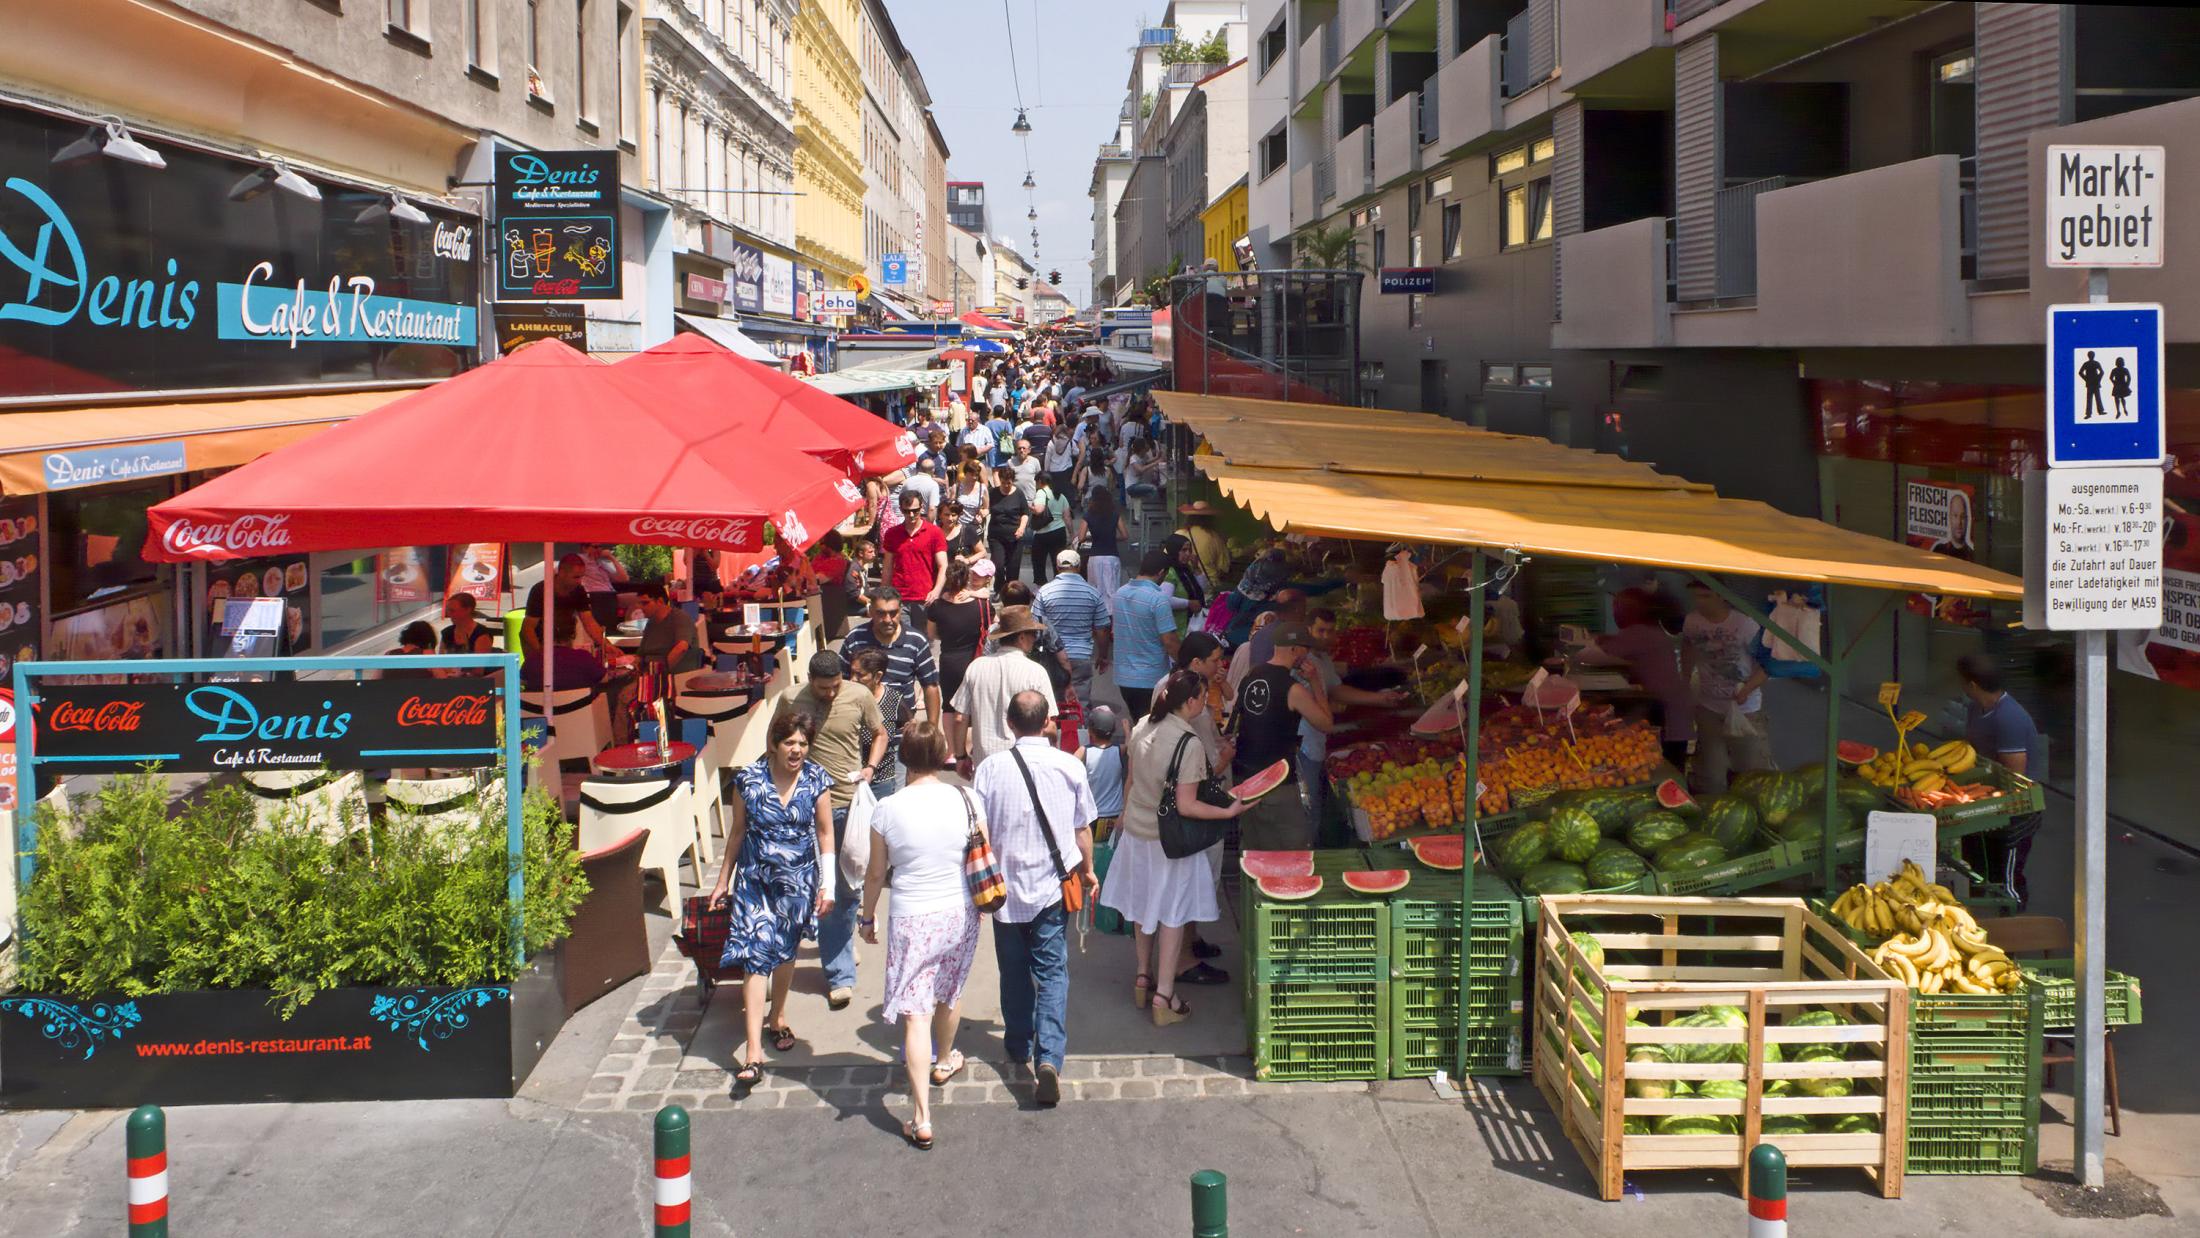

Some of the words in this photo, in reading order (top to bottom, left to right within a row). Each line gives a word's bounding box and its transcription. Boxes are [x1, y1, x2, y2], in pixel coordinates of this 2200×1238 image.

[510, 154, 599, 184] Denis
[2060, 153, 2154, 196] Markt-
[518, 186, 540, 200] Cafe
[550, 186, 598, 198] Restaurant
[2060, 203, 2152, 260] gebiet
[0, 176, 199, 329] Denis
[1384, 278, 1425, 286] POLIZEI
[240, 262, 316, 349] Cafe
[323, 275, 343, 337] &
[348, 276, 461, 342] Restaurant
[812, 290, 855, 312] deha
[510, 323, 572, 332] LAHMACUN
[564, 331, 583, 340] 3,50
[46, 454, 105, 484] Denis
[111, 458, 132, 477] Cafe
[141, 455, 182, 472] Restaurant
[1909, 484, 1948, 507] FRISCH
[2072, 484, 2140, 496] ausgenommen
[1909, 505, 1948, 527] FLEISCH
[162, 514, 291, 554] Coca-Cola
[629, 516, 752, 545] Coca-Cola
[2052, 560, 2066, 571] die
[2071, 559, 2105, 571] Zufahrt
[2110, 559, 2125, 570] auf
[2129, 558, 2157, 570] Dauer
[2049, 578, 2074, 589] einer
[2144, 575, 2160, 587] mit
[2053, 598, 2108, 612] Bewilligung
[2112, 597, 2127, 609] der
[2131, 596, 2157, 610] MA59
[185, 685, 351, 742] Denis
[397, 695, 492, 727] Coca-Cola
[213, 748, 244, 768] Cafe
[245, 750, 256, 764] &
[257, 747, 322, 764] Restaurant
[136, 1035, 372, 1057] www.denis-restaurant.at
